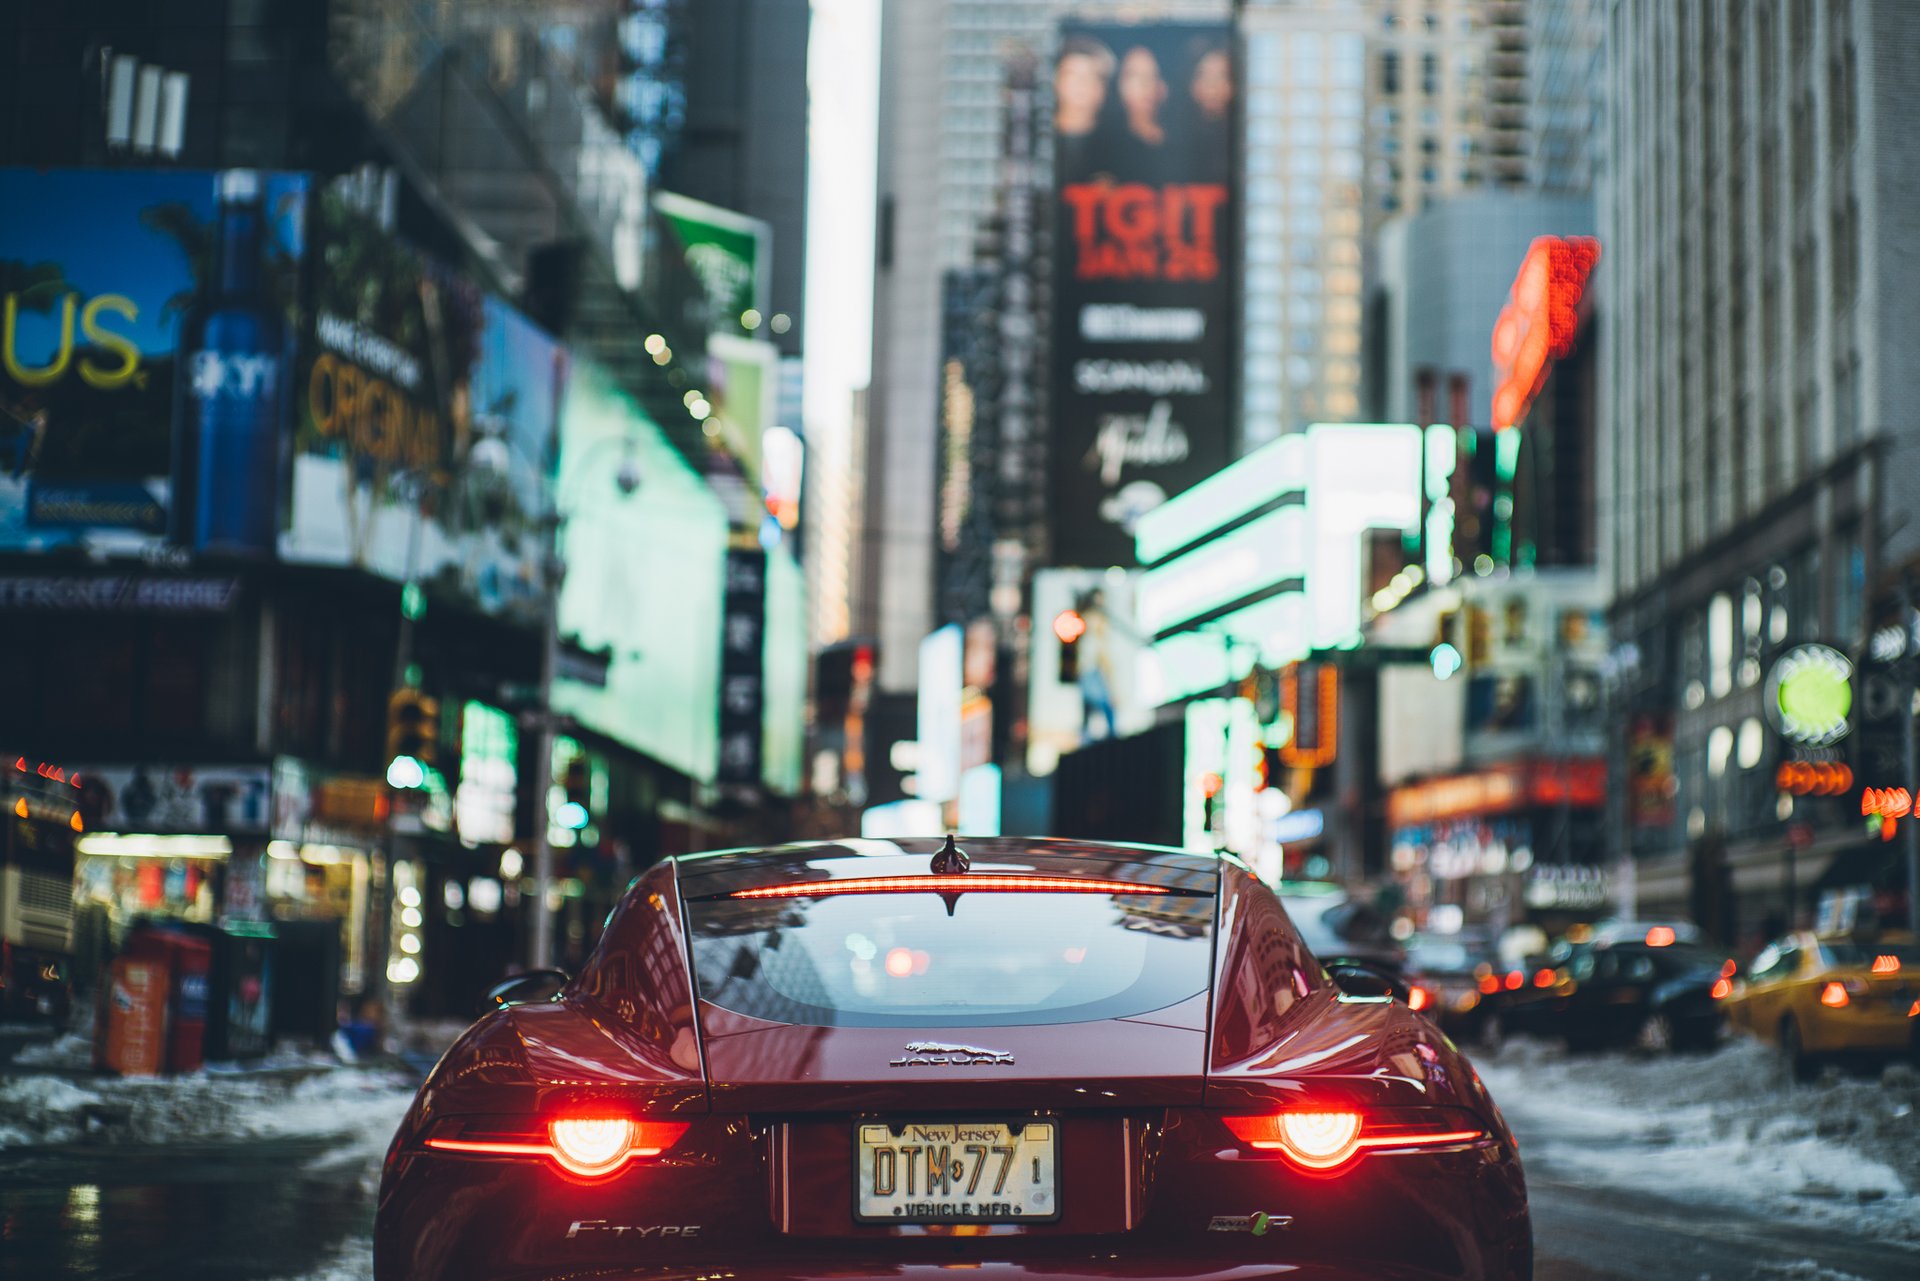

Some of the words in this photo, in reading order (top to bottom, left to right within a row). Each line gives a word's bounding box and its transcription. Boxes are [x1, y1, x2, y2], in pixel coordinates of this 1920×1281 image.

[1063, 183, 1227, 244] TGIT
[889, 1056, 1015, 1067] JAGUAR
[912, 1126, 950, 1143] New
[951, 1126, 1000, 1144] Jersey
[904, 1203, 971, 1216] VEHICLE
[978, 1203, 1012, 1216] MFR
[565, 1220, 700, 1238] F-TYPE
